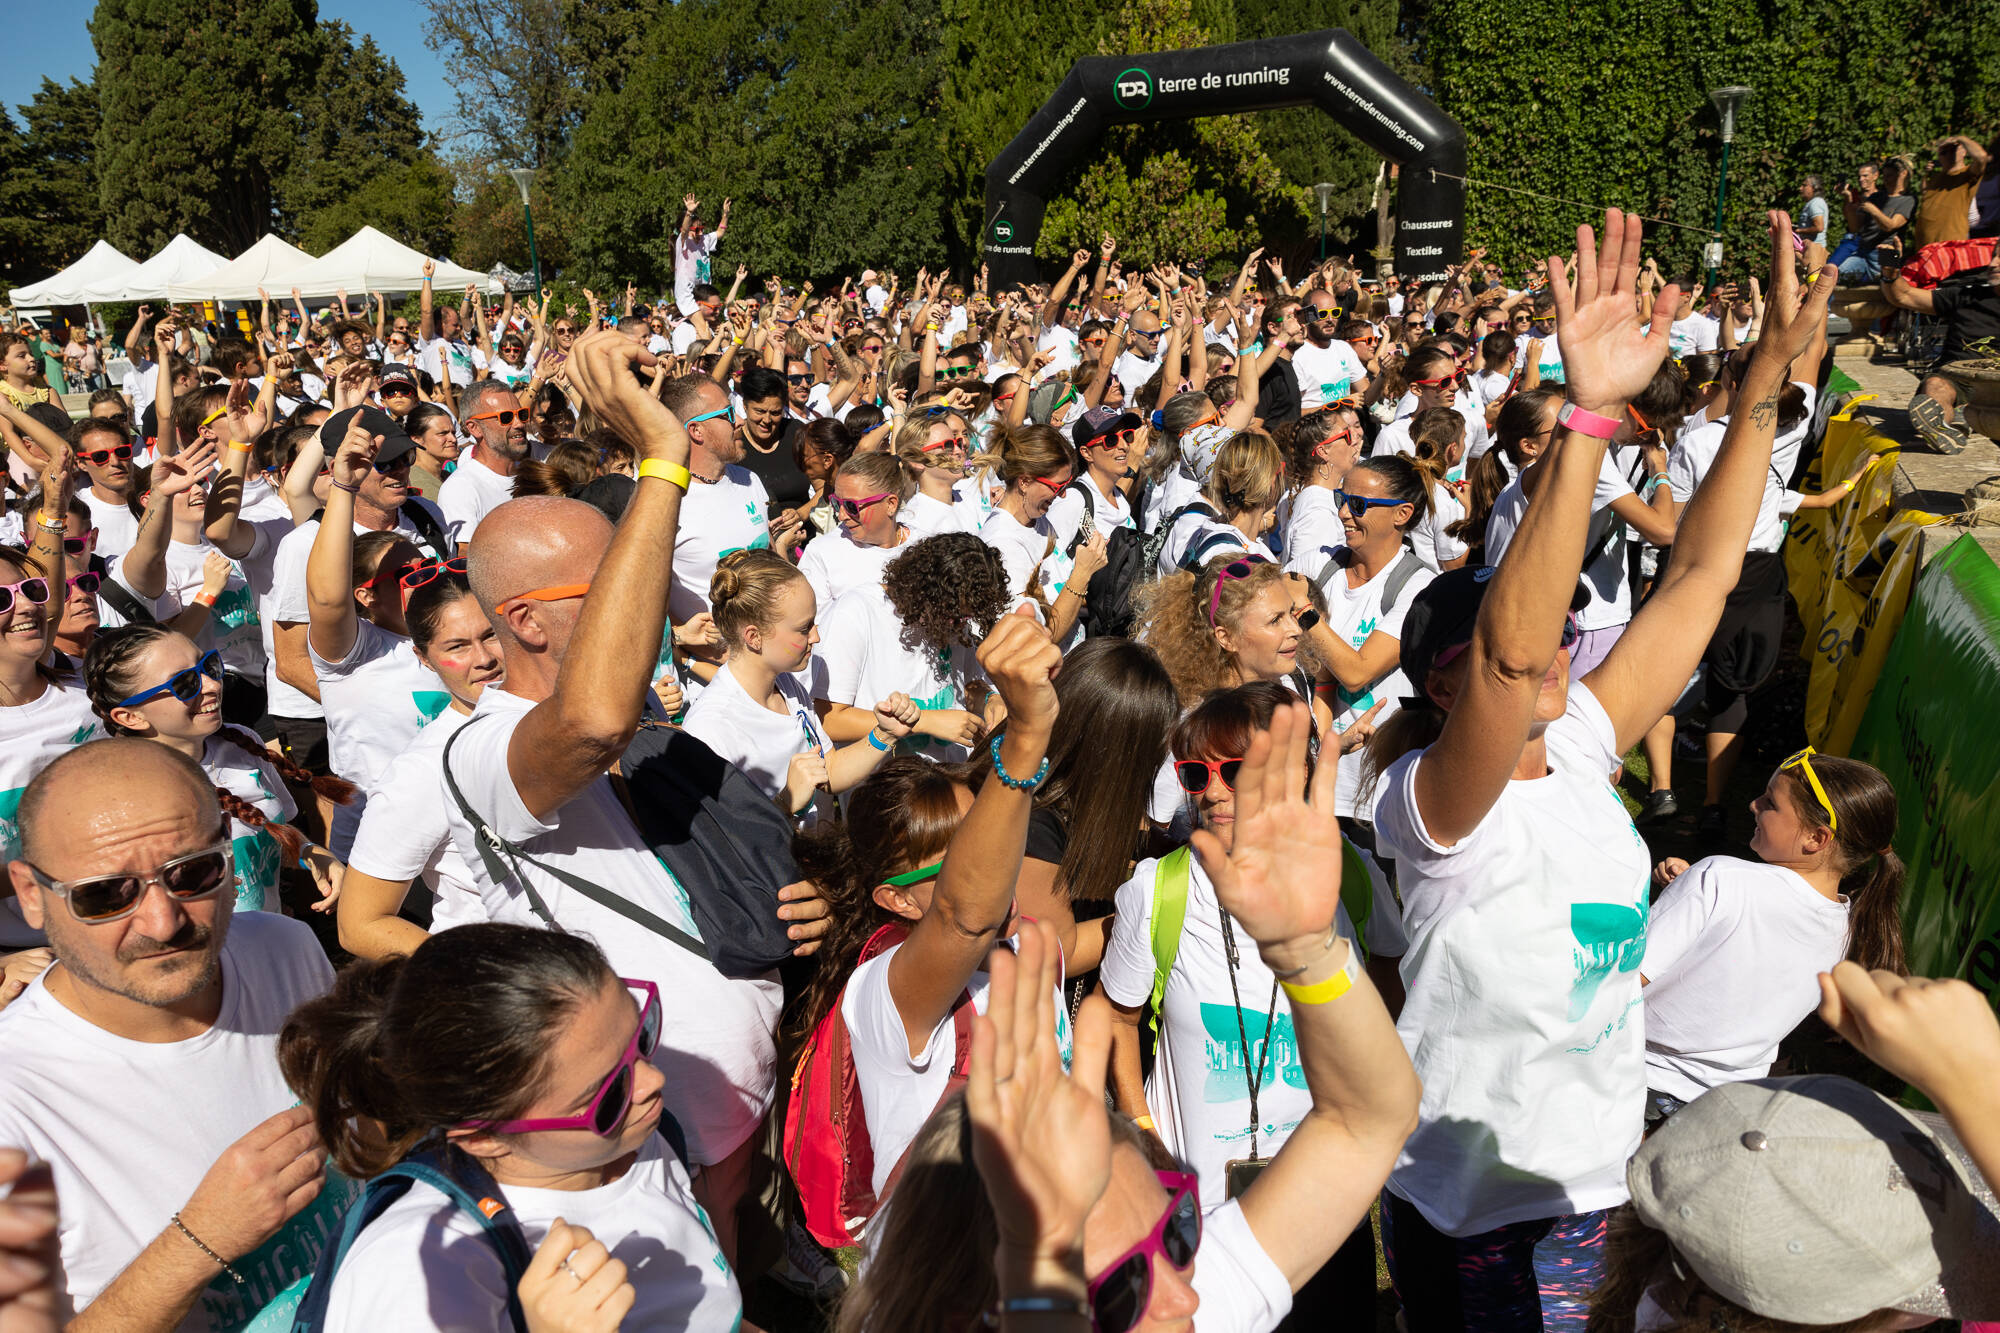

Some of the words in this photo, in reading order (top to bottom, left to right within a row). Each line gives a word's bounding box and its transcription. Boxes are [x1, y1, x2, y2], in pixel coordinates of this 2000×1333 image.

[1158, 77, 1198, 93] terre
[1200, 72, 1222, 90] de
[1225, 66, 1291, 86] running
[1117, 81, 1149, 98] TDR
[1323, 71, 1425, 152] www.terrederunning.com
[1008, 97, 1087, 185] www.terrederunning.com
[1401, 219, 1453, 230] Chaussures
[992, 243, 1002, 253] de
[1002, 244, 1032, 255] running
[1405, 245, 1443, 256] Textiles
